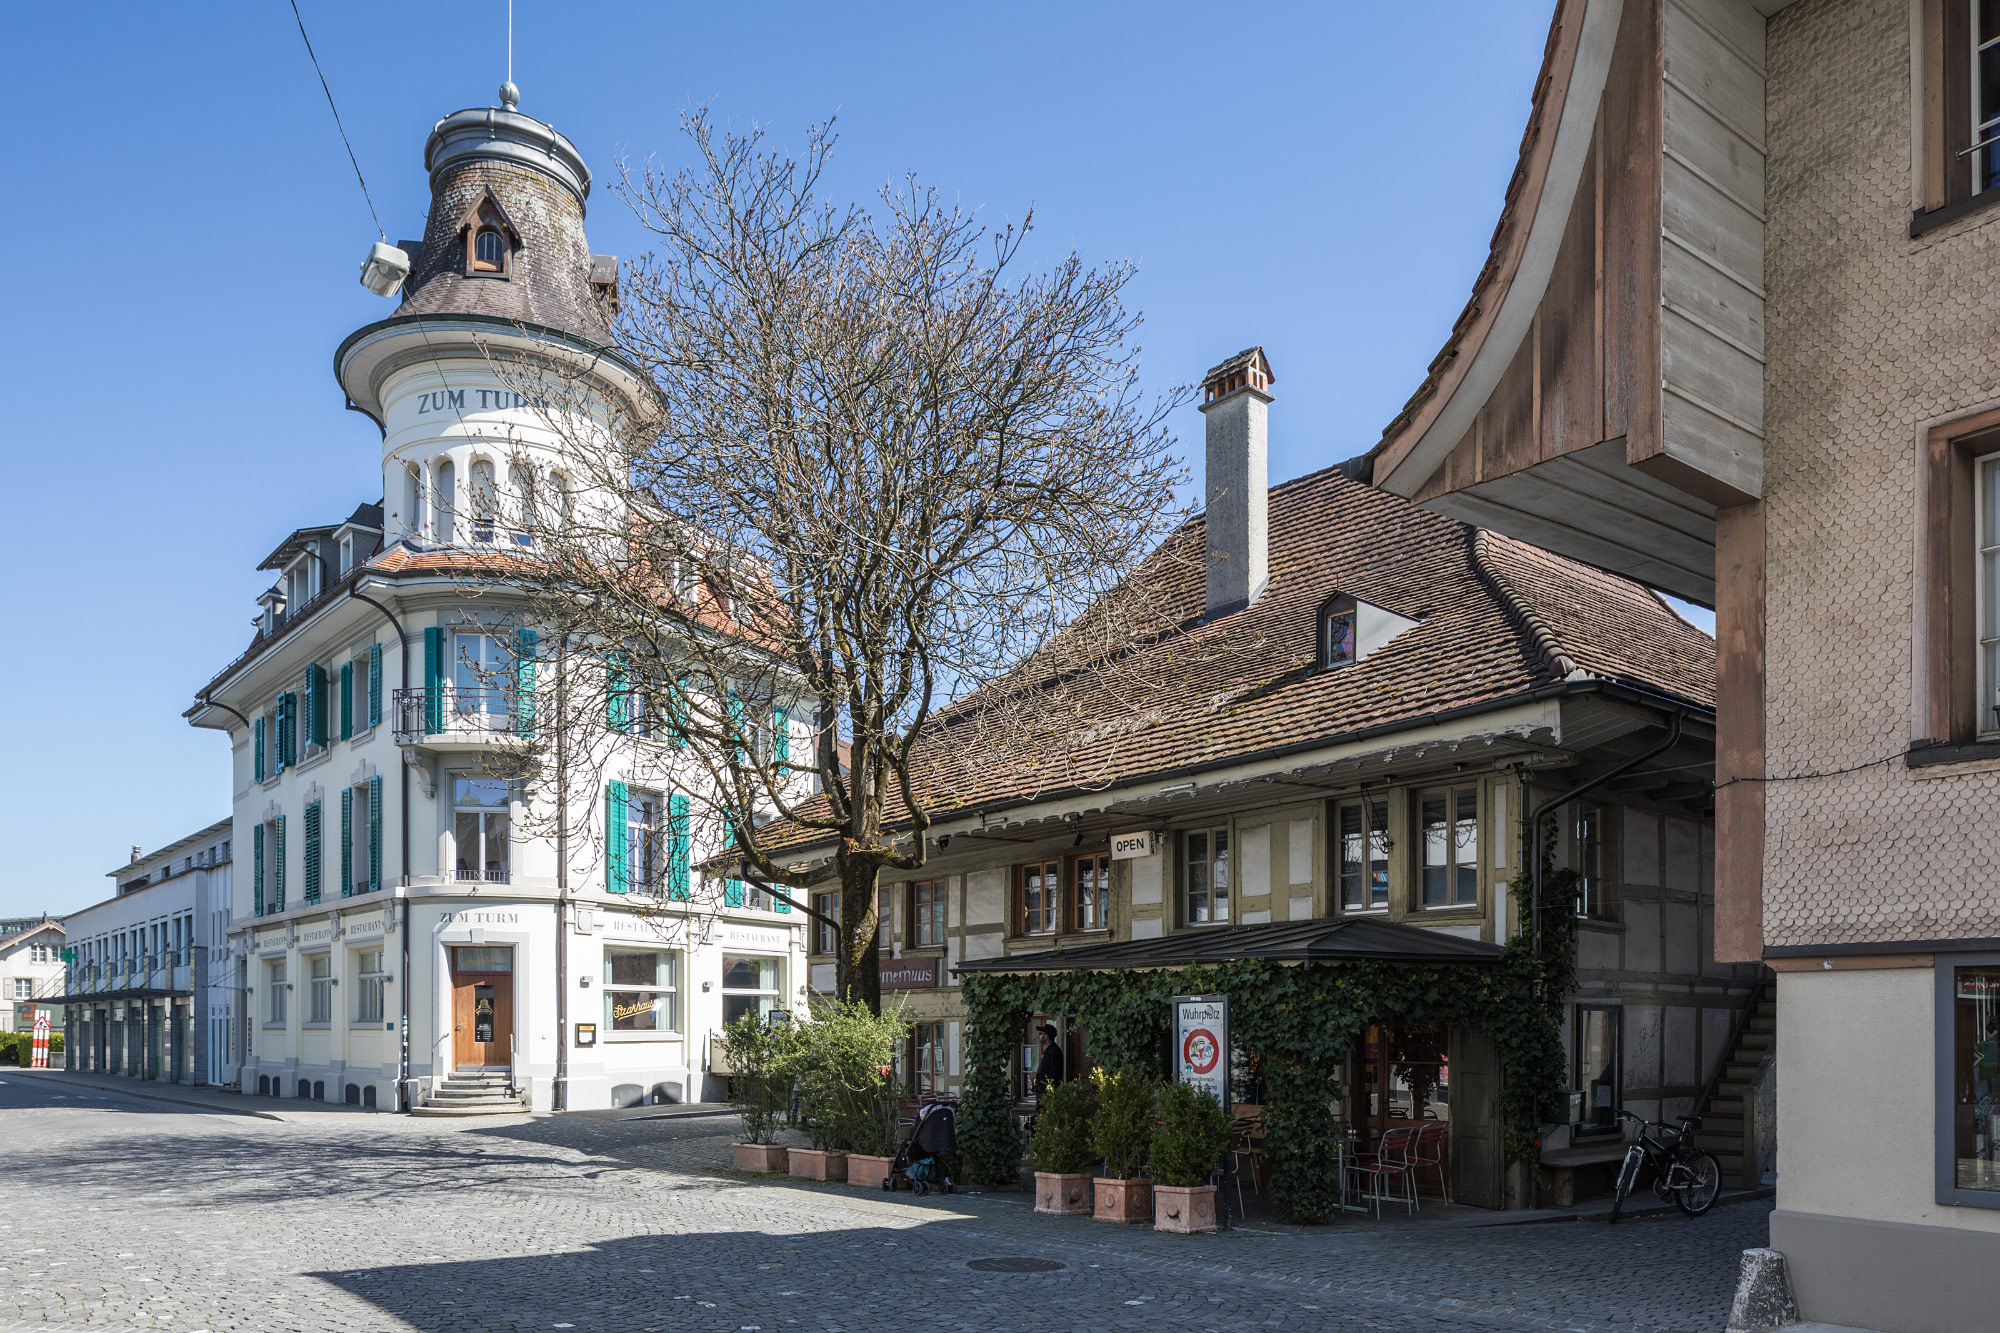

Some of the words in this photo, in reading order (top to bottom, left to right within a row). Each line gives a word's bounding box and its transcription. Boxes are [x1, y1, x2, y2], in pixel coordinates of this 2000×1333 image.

[418, 389, 466, 415] ZUM
[1116, 838, 1144, 852] OPEN
[440, 912, 468, 923] ZUM
[475, 912, 519, 924] TURM
[350, 920, 381, 935] RESTAURANT
[303, 929, 330, 942] RESTAURANT
[730, 931, 781, 944] RESTAURANT
